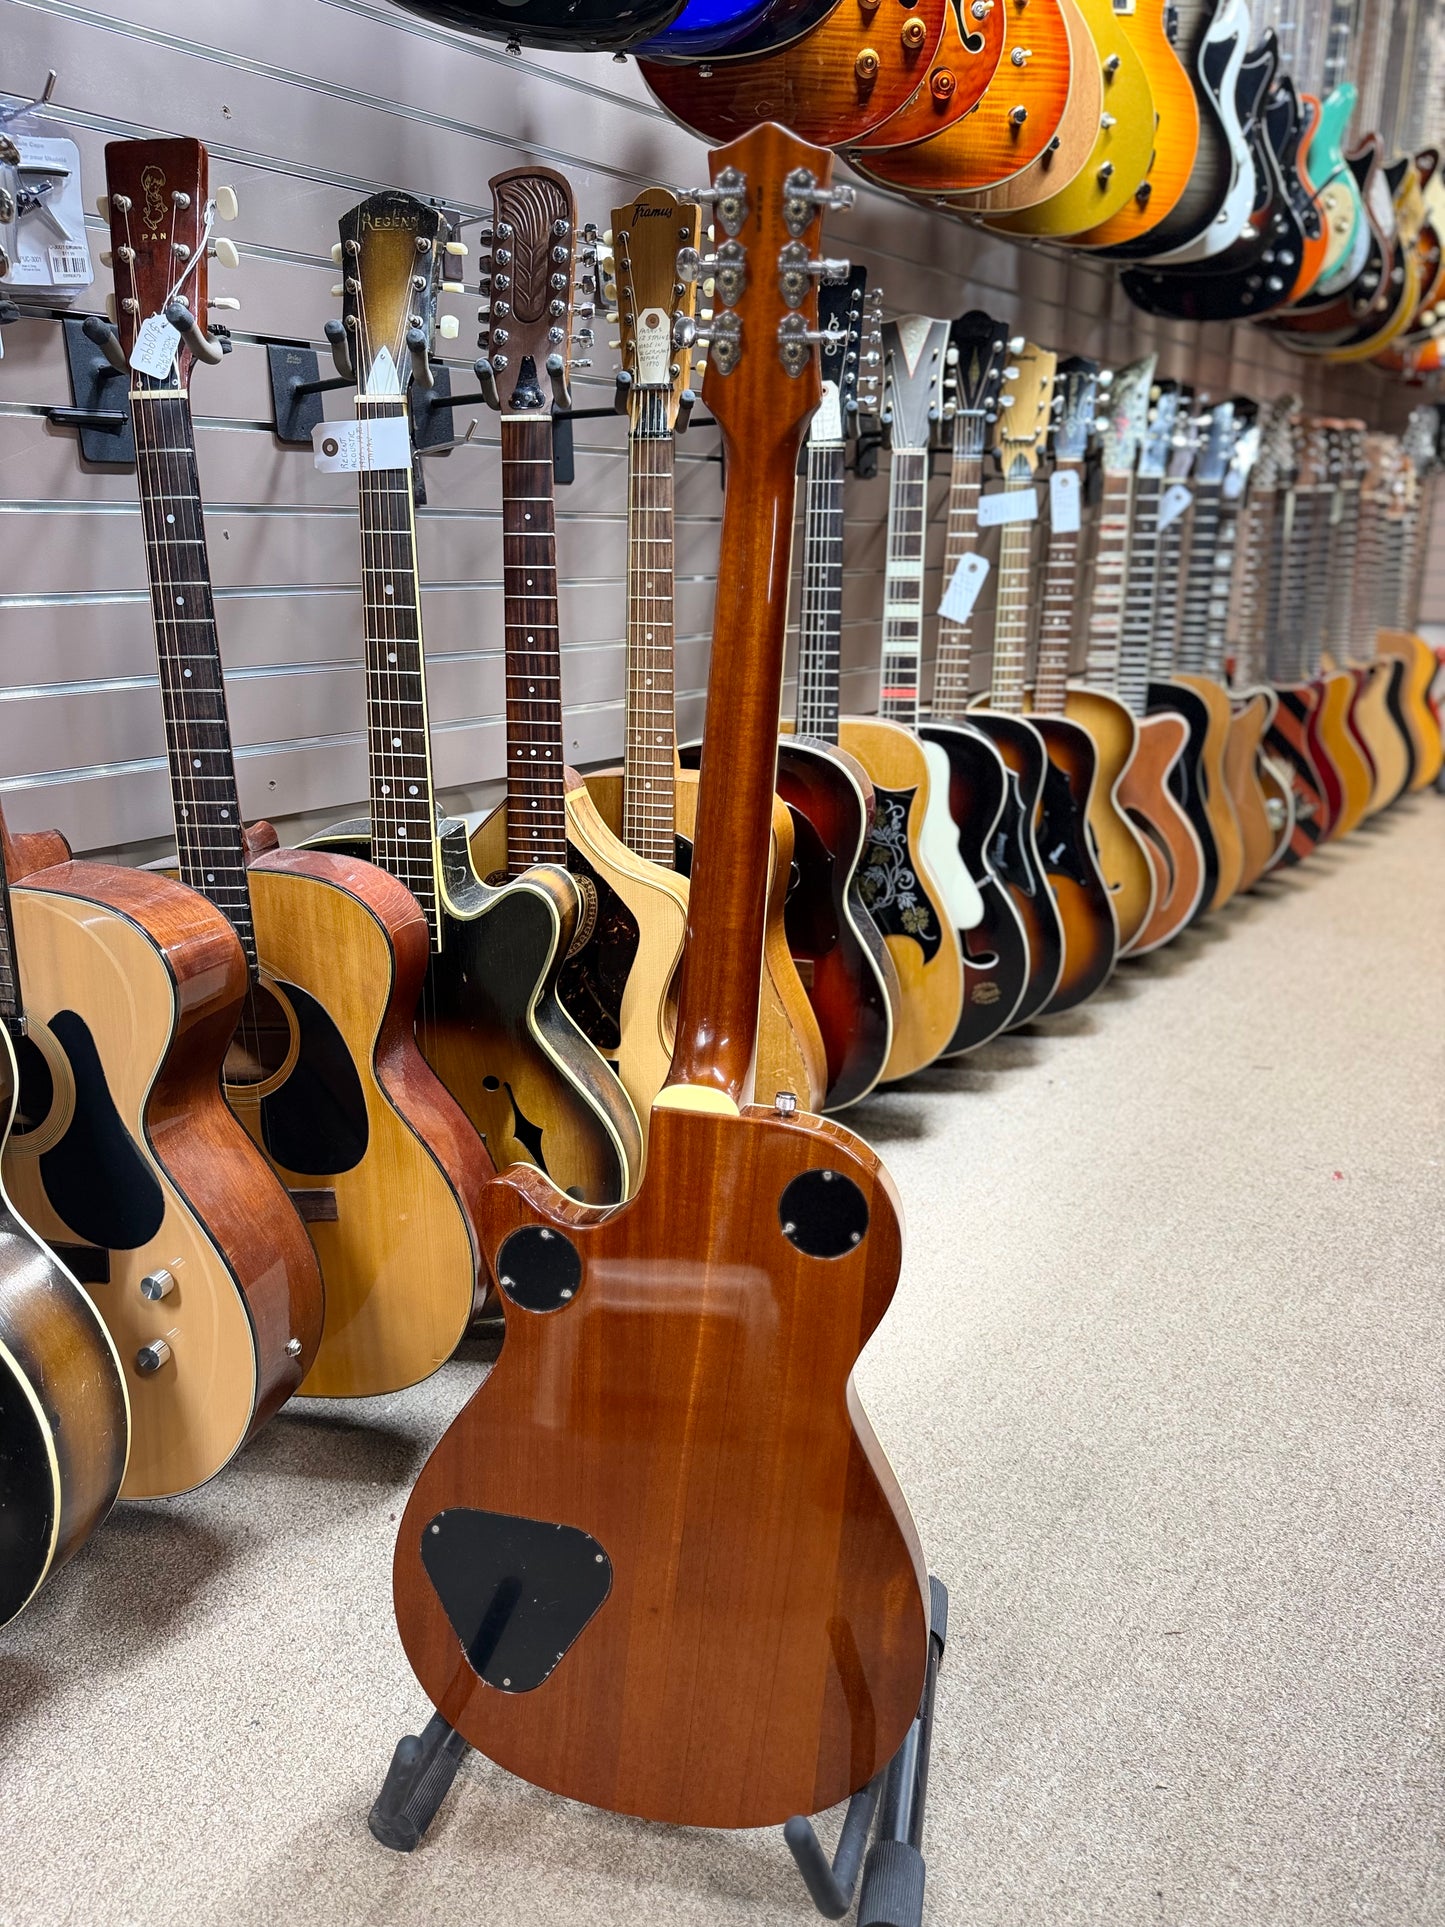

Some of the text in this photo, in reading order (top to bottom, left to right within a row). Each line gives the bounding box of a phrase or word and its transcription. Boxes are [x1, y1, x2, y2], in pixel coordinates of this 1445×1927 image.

[632, 203, 672, 227] Framus
[141, 232, 167, 240] PAN
[340, 438, 348, 469] REGENT
[348, 430, 357, 469] ACOUSTIC
